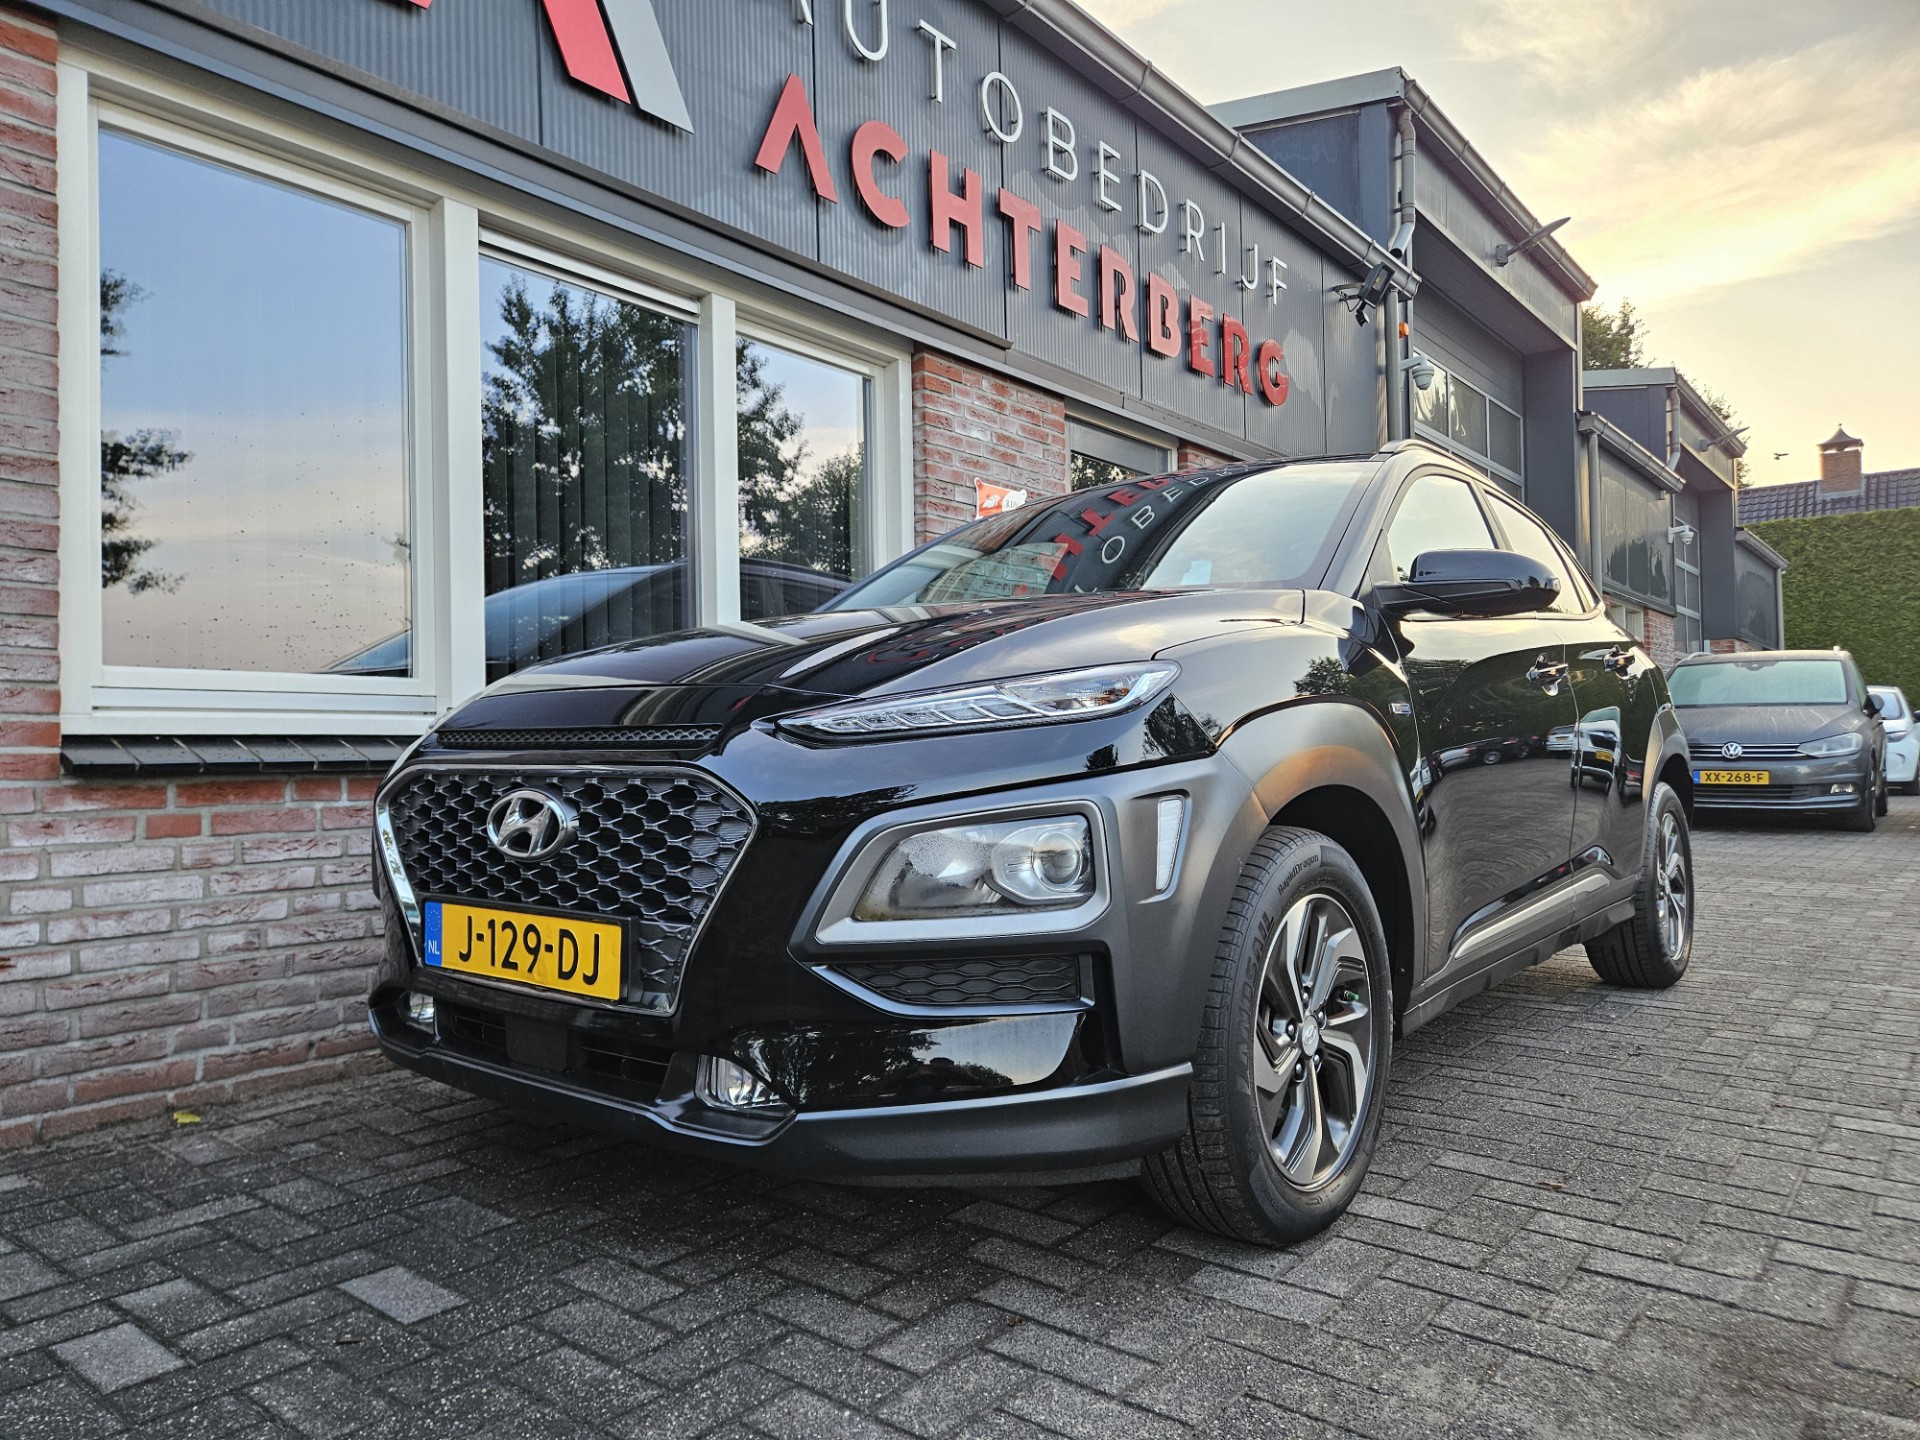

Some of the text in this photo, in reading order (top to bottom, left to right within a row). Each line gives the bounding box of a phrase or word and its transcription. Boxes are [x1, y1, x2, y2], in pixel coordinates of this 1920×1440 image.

[799, 0, 1288, 304] UTOBEDRIJF
[755, 73, 1289, 406] ACHTERBERG
[1704, 772, 1764, 783] XX-268-F
[1277, 854, 1319, 896] RapidDragon
[428, 940, 440, 955] NL
[458, 915, 600, 986] J-129-DJ
